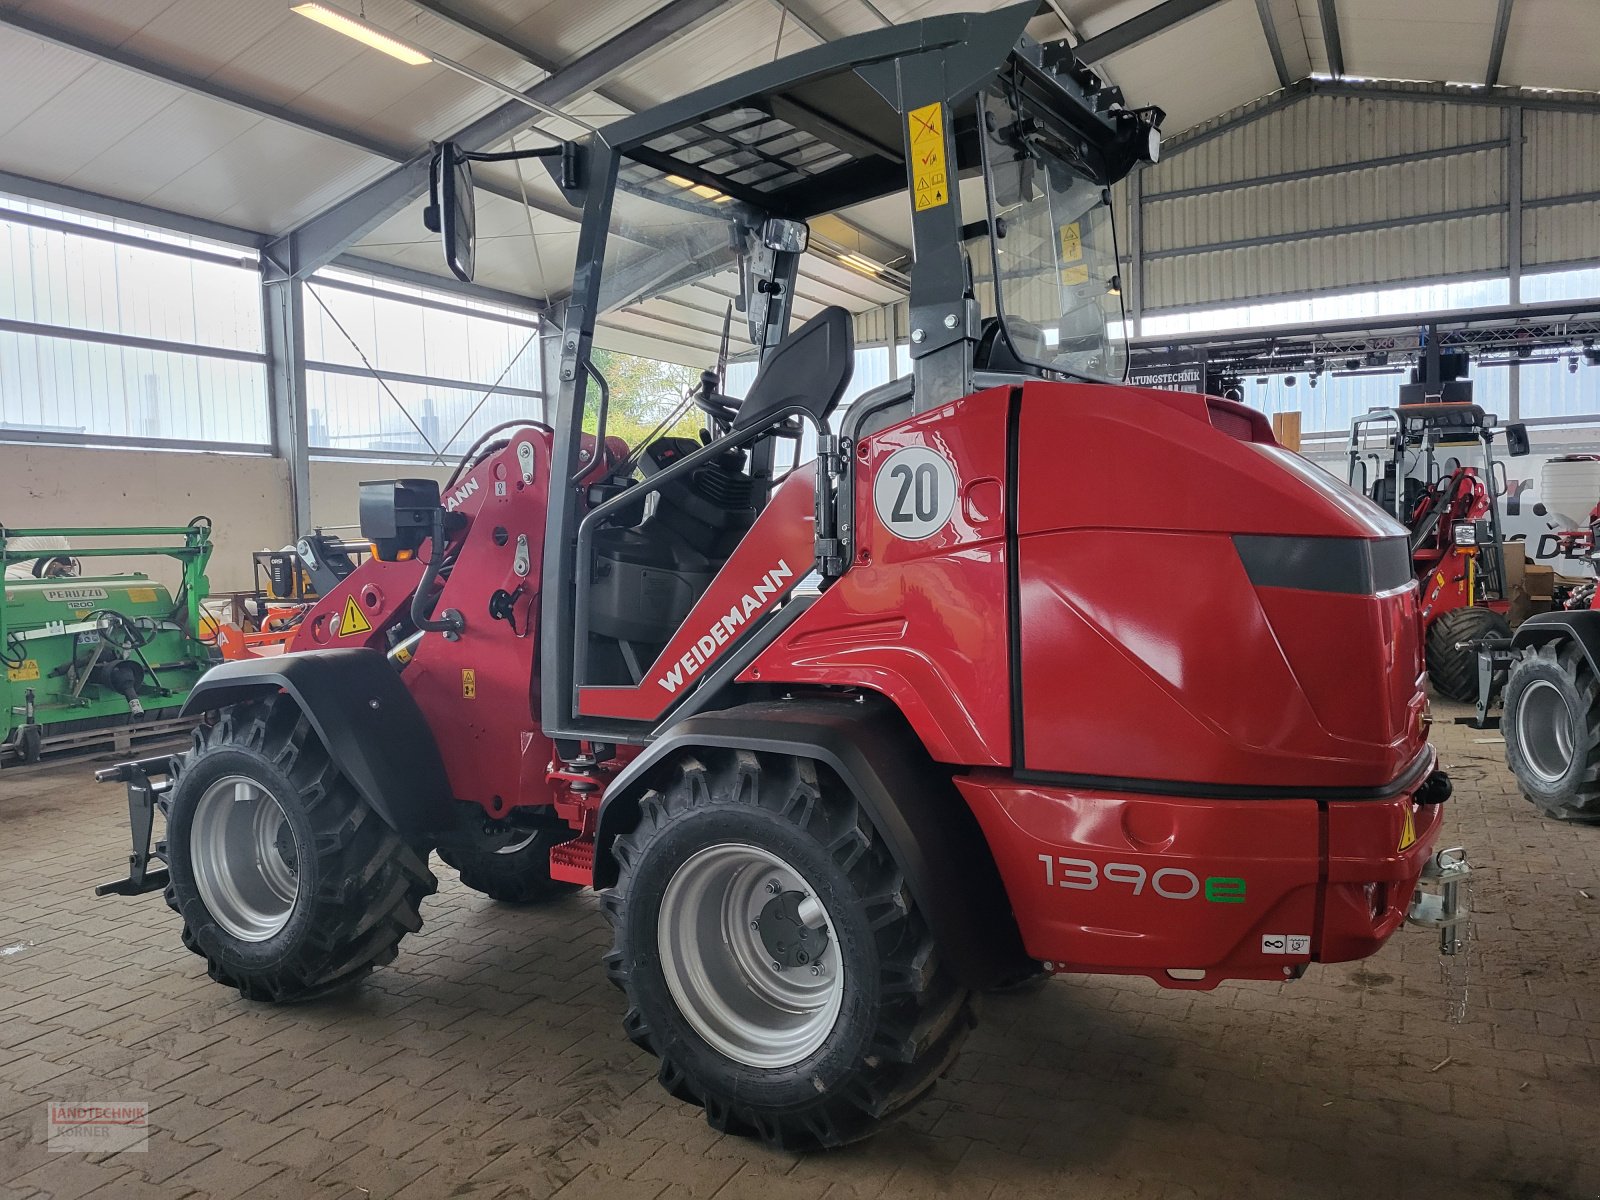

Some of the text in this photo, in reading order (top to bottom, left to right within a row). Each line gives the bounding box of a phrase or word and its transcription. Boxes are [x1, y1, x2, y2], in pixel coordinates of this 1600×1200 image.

[891, 463, 938, 522] 20
[49, 588, 102, 599] PERUZZO
[658, 559, 793, 693] WEIDEMANN
